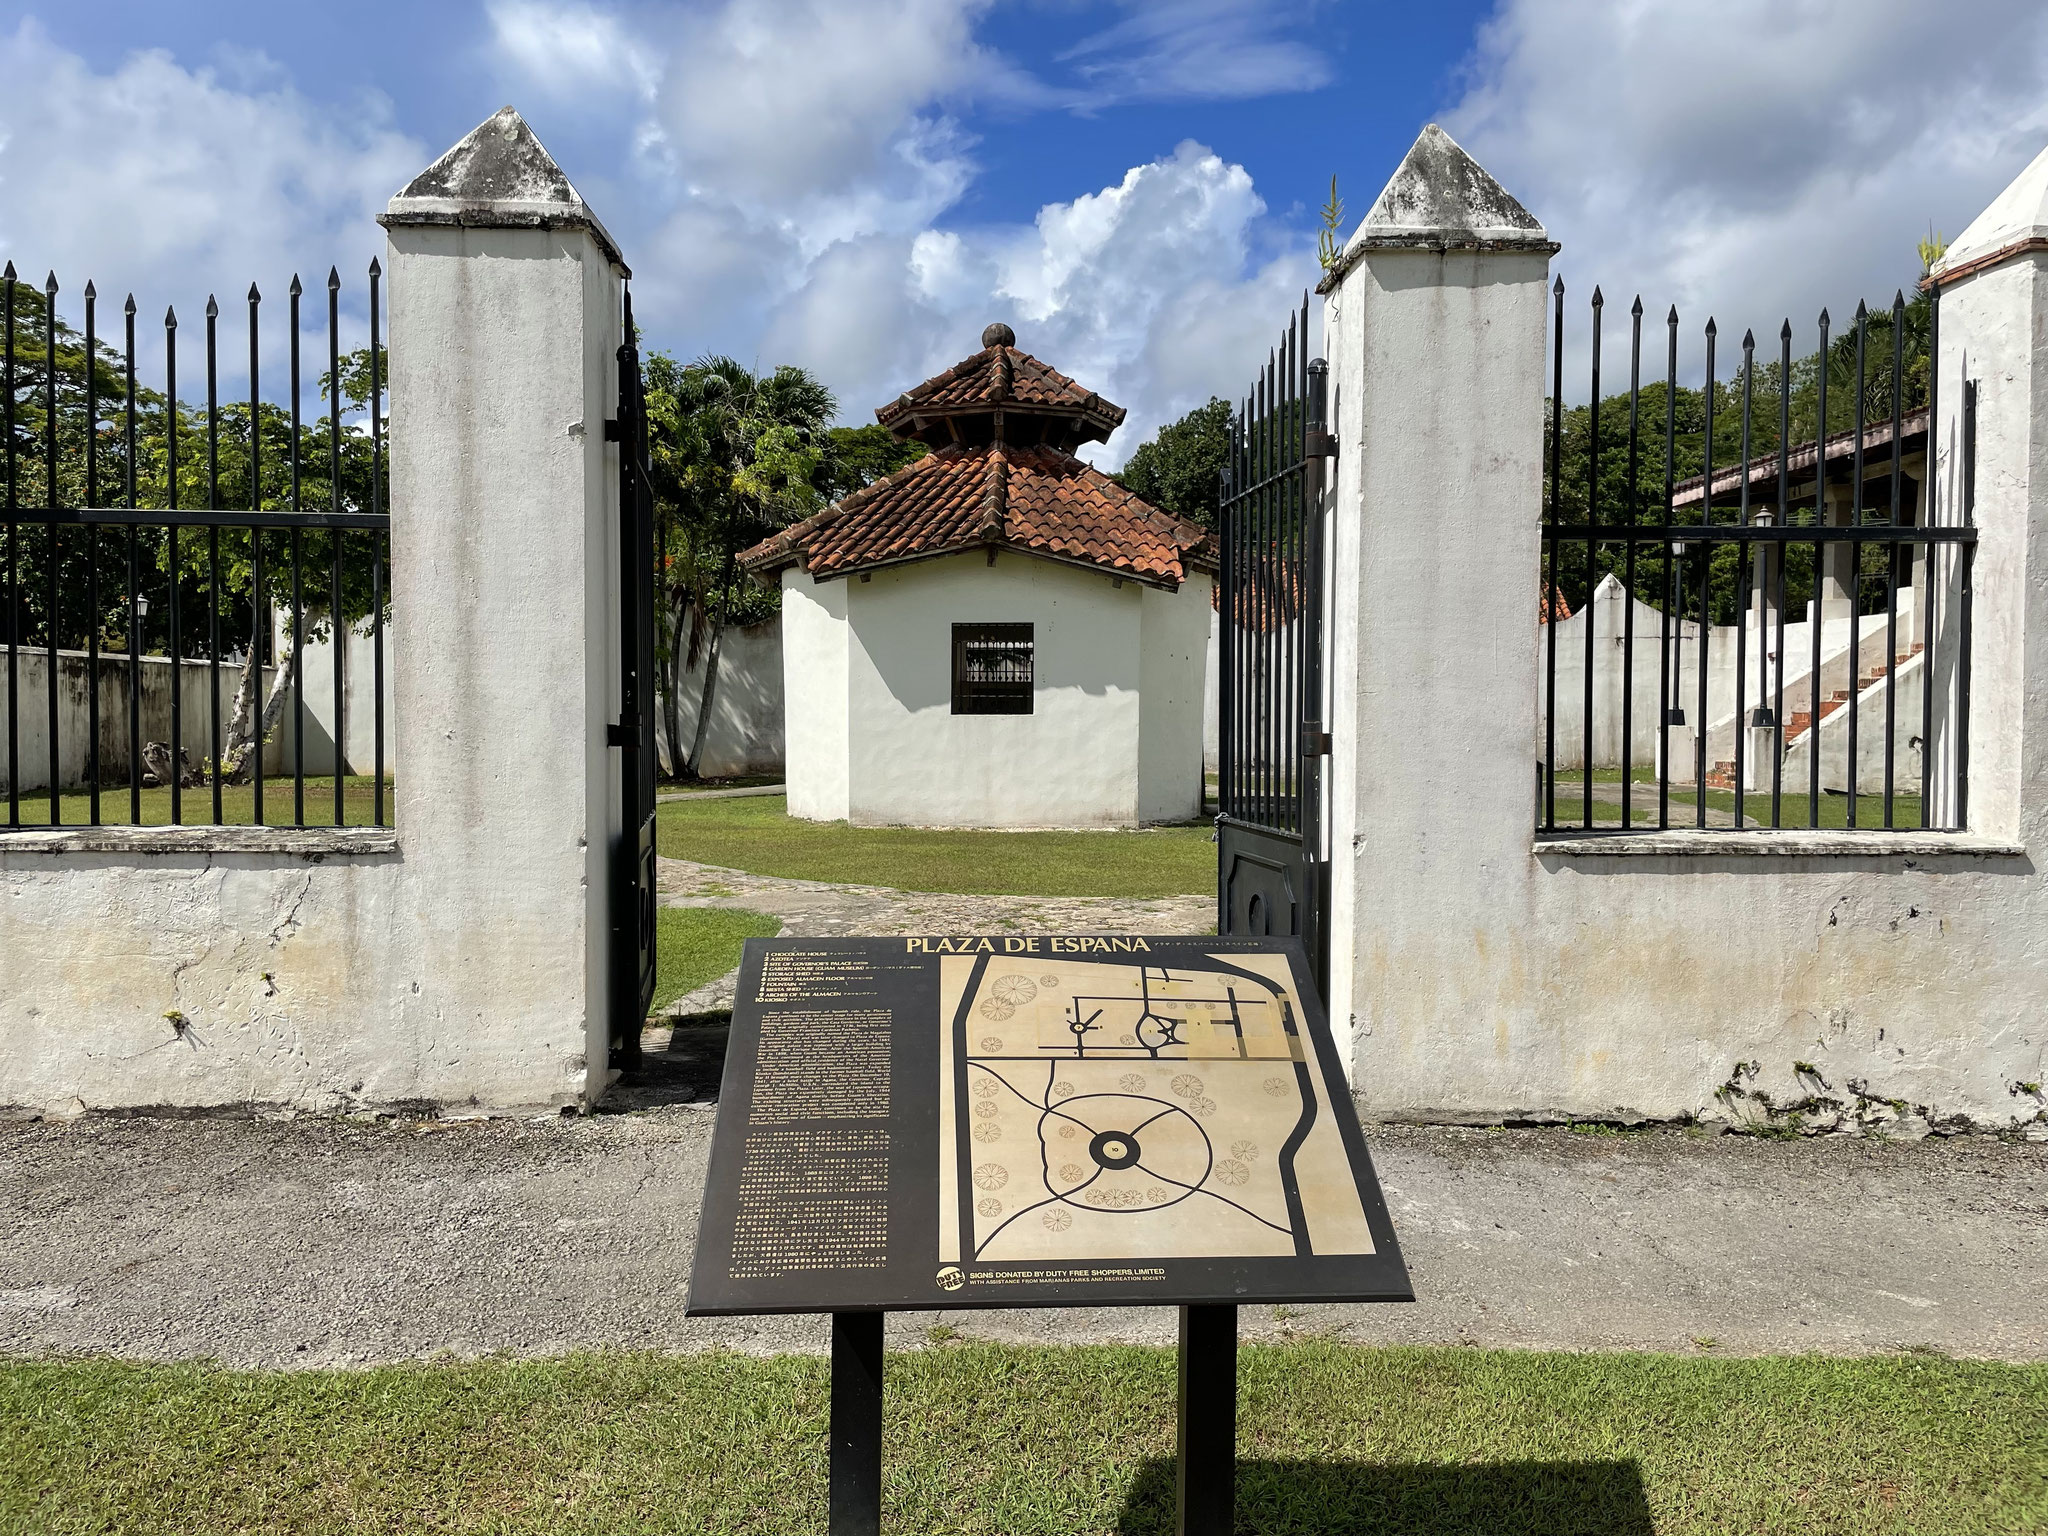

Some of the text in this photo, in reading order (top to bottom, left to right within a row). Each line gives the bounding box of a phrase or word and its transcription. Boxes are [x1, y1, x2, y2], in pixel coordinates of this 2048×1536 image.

[906, 936, 1151, 952] PLAZA DE ESPANA
[936, 1270, 962, 1284] DUTY
[940, 1276, 964, 1288] FREE
